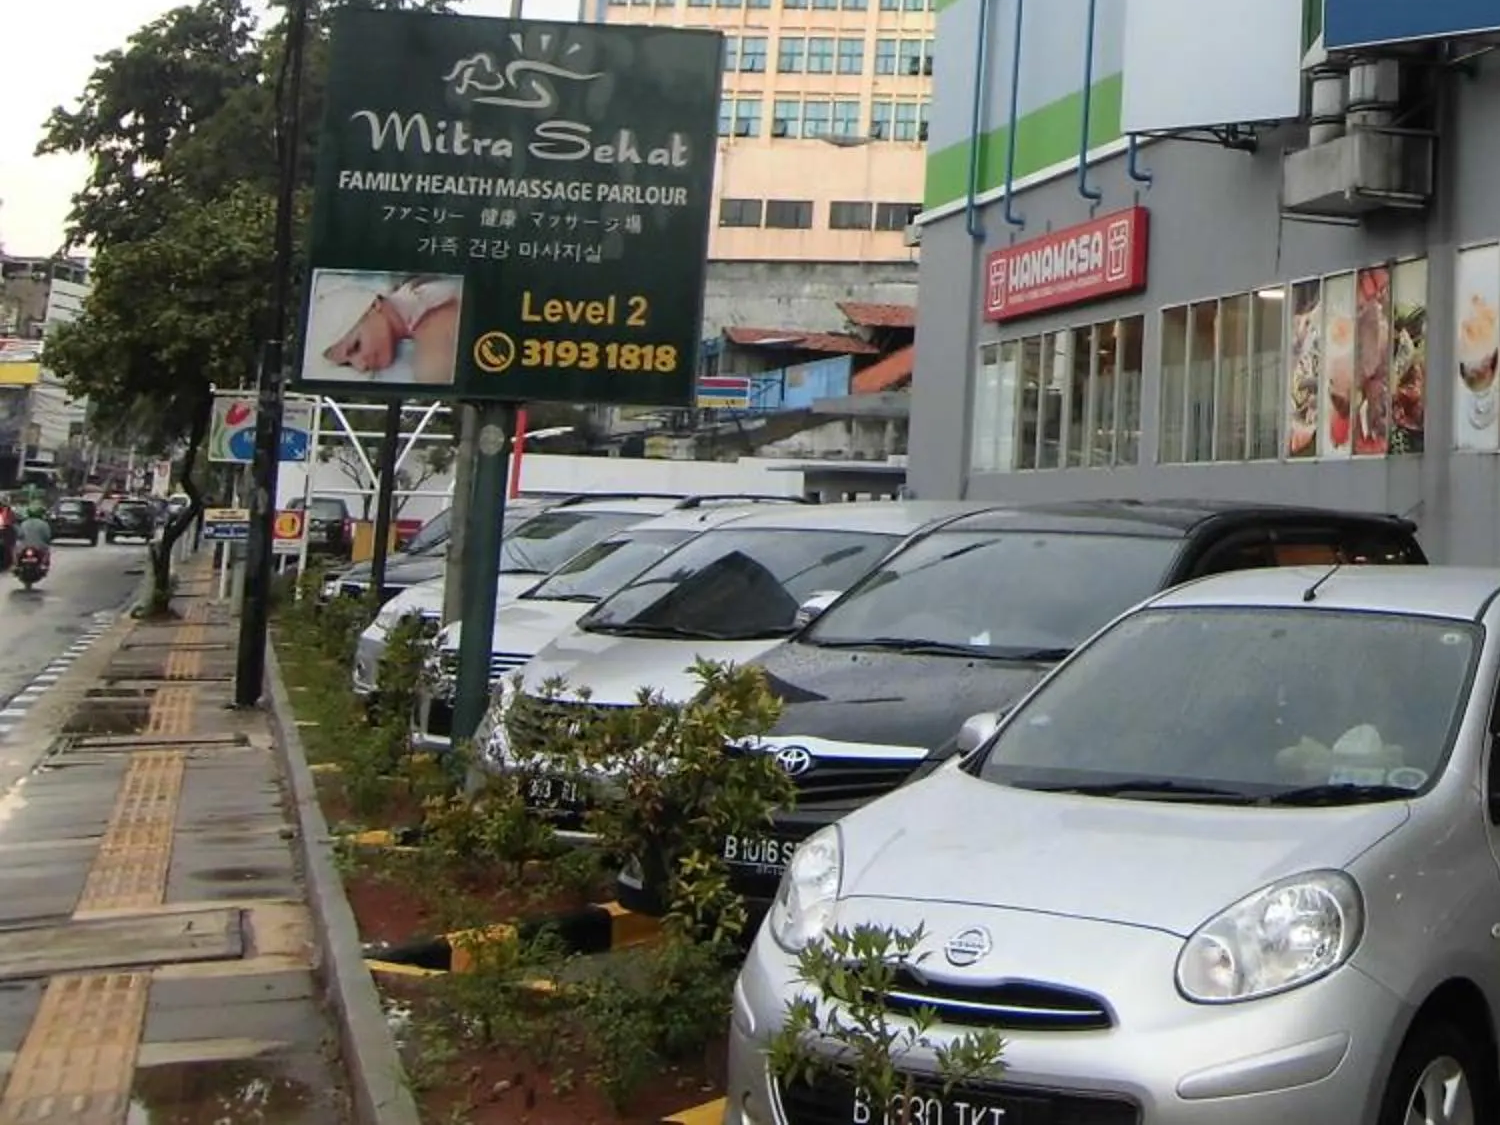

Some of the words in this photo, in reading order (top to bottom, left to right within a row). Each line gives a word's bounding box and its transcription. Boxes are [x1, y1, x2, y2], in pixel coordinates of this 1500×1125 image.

[352, 110, 513, 158] Mitra
[528, 120, 689, 169] Sehat
[339, 170, 413, 192] FAMILY
[415, 174, 493, 197] HEALTH
[497, 177, 593, 202] MASSAGE
[597, 182, 688, 206] PARLOUR
[417, 237, 459, 258] 가족
[469, 238, 510, 259] 건강
[1009, 231, 1103, 293] HANAMASA
[521, 291, 615, 325] Level
[625, 296, 648, 327] 2
[521, 339, 600, 368] 3193
[605, 343, 677, 373] 1818
[725, 835, 738, 859] B
[853, 1086, 871, 1124] B
